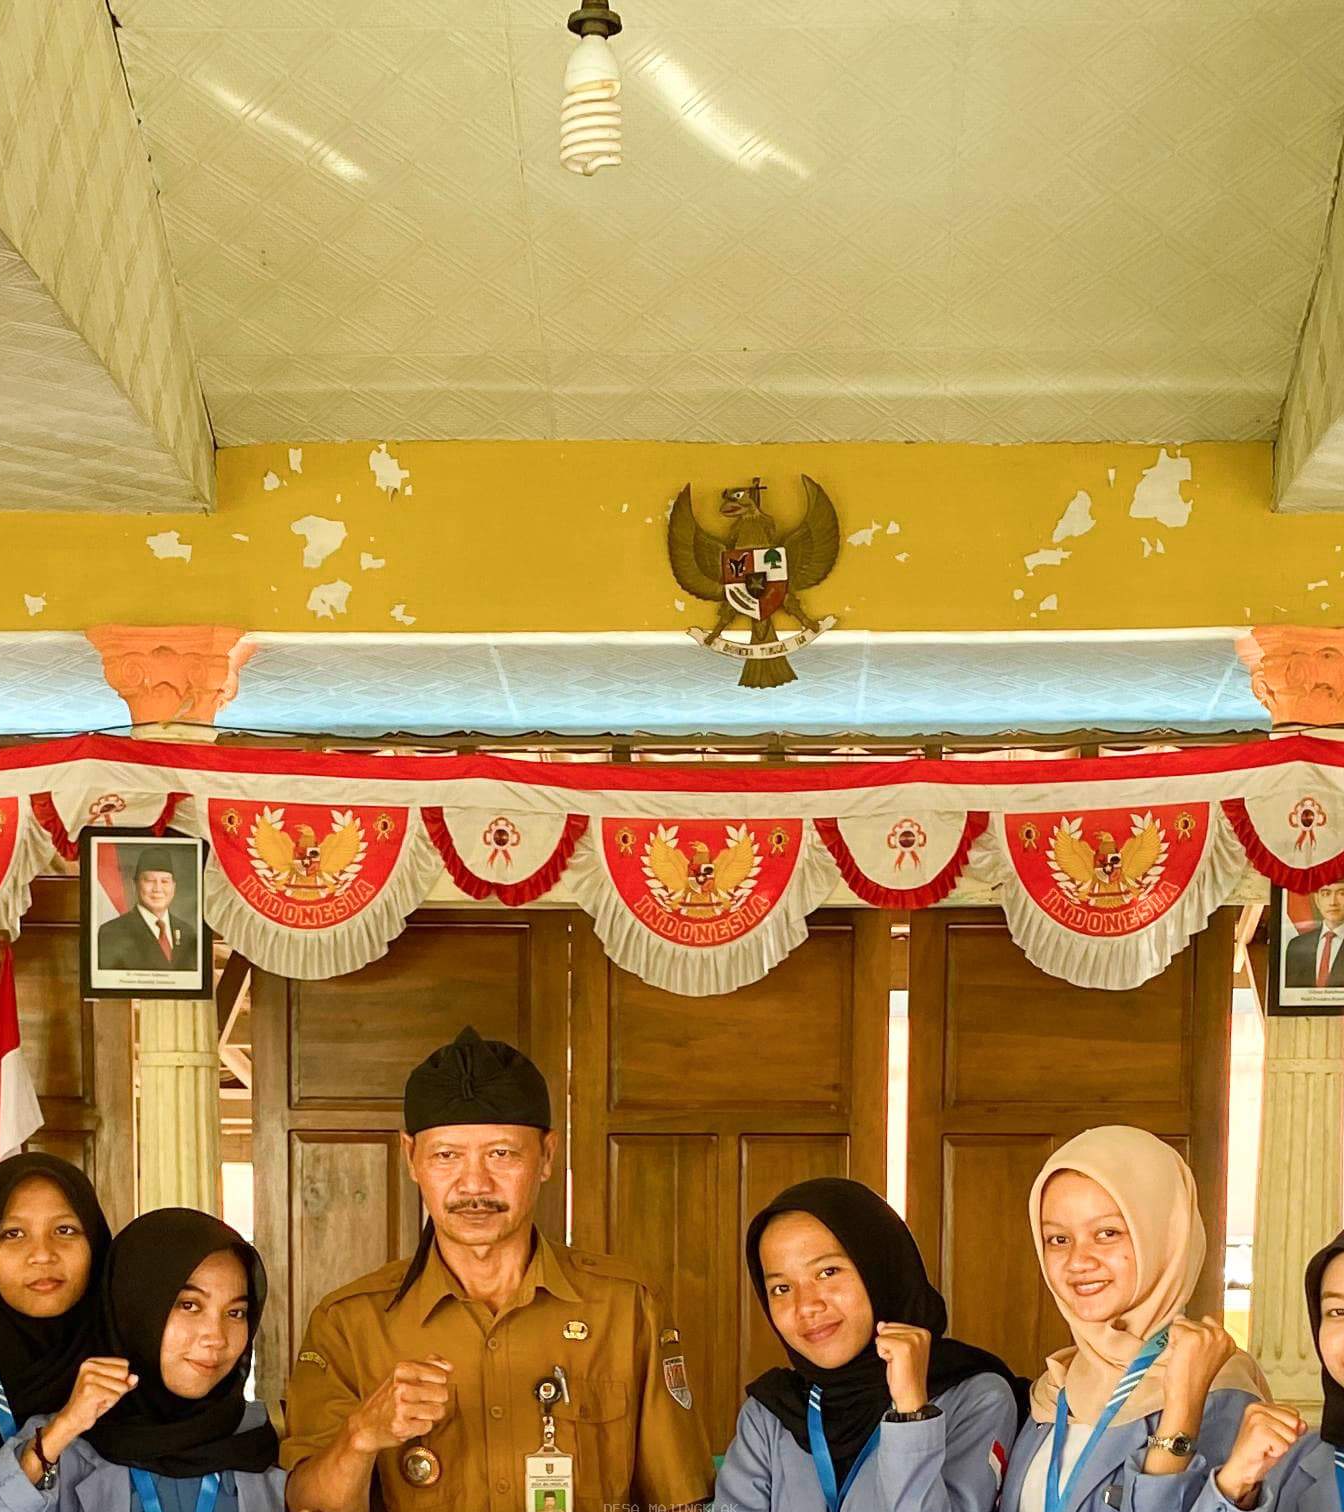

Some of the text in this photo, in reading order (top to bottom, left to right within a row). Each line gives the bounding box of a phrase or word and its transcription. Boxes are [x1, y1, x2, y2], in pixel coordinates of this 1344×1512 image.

[238, 876, 376, 926] INDONESIA
[634, 894, 771, 943] INDONESIA
[1041, 880, 1181, 933] INDONESIA
